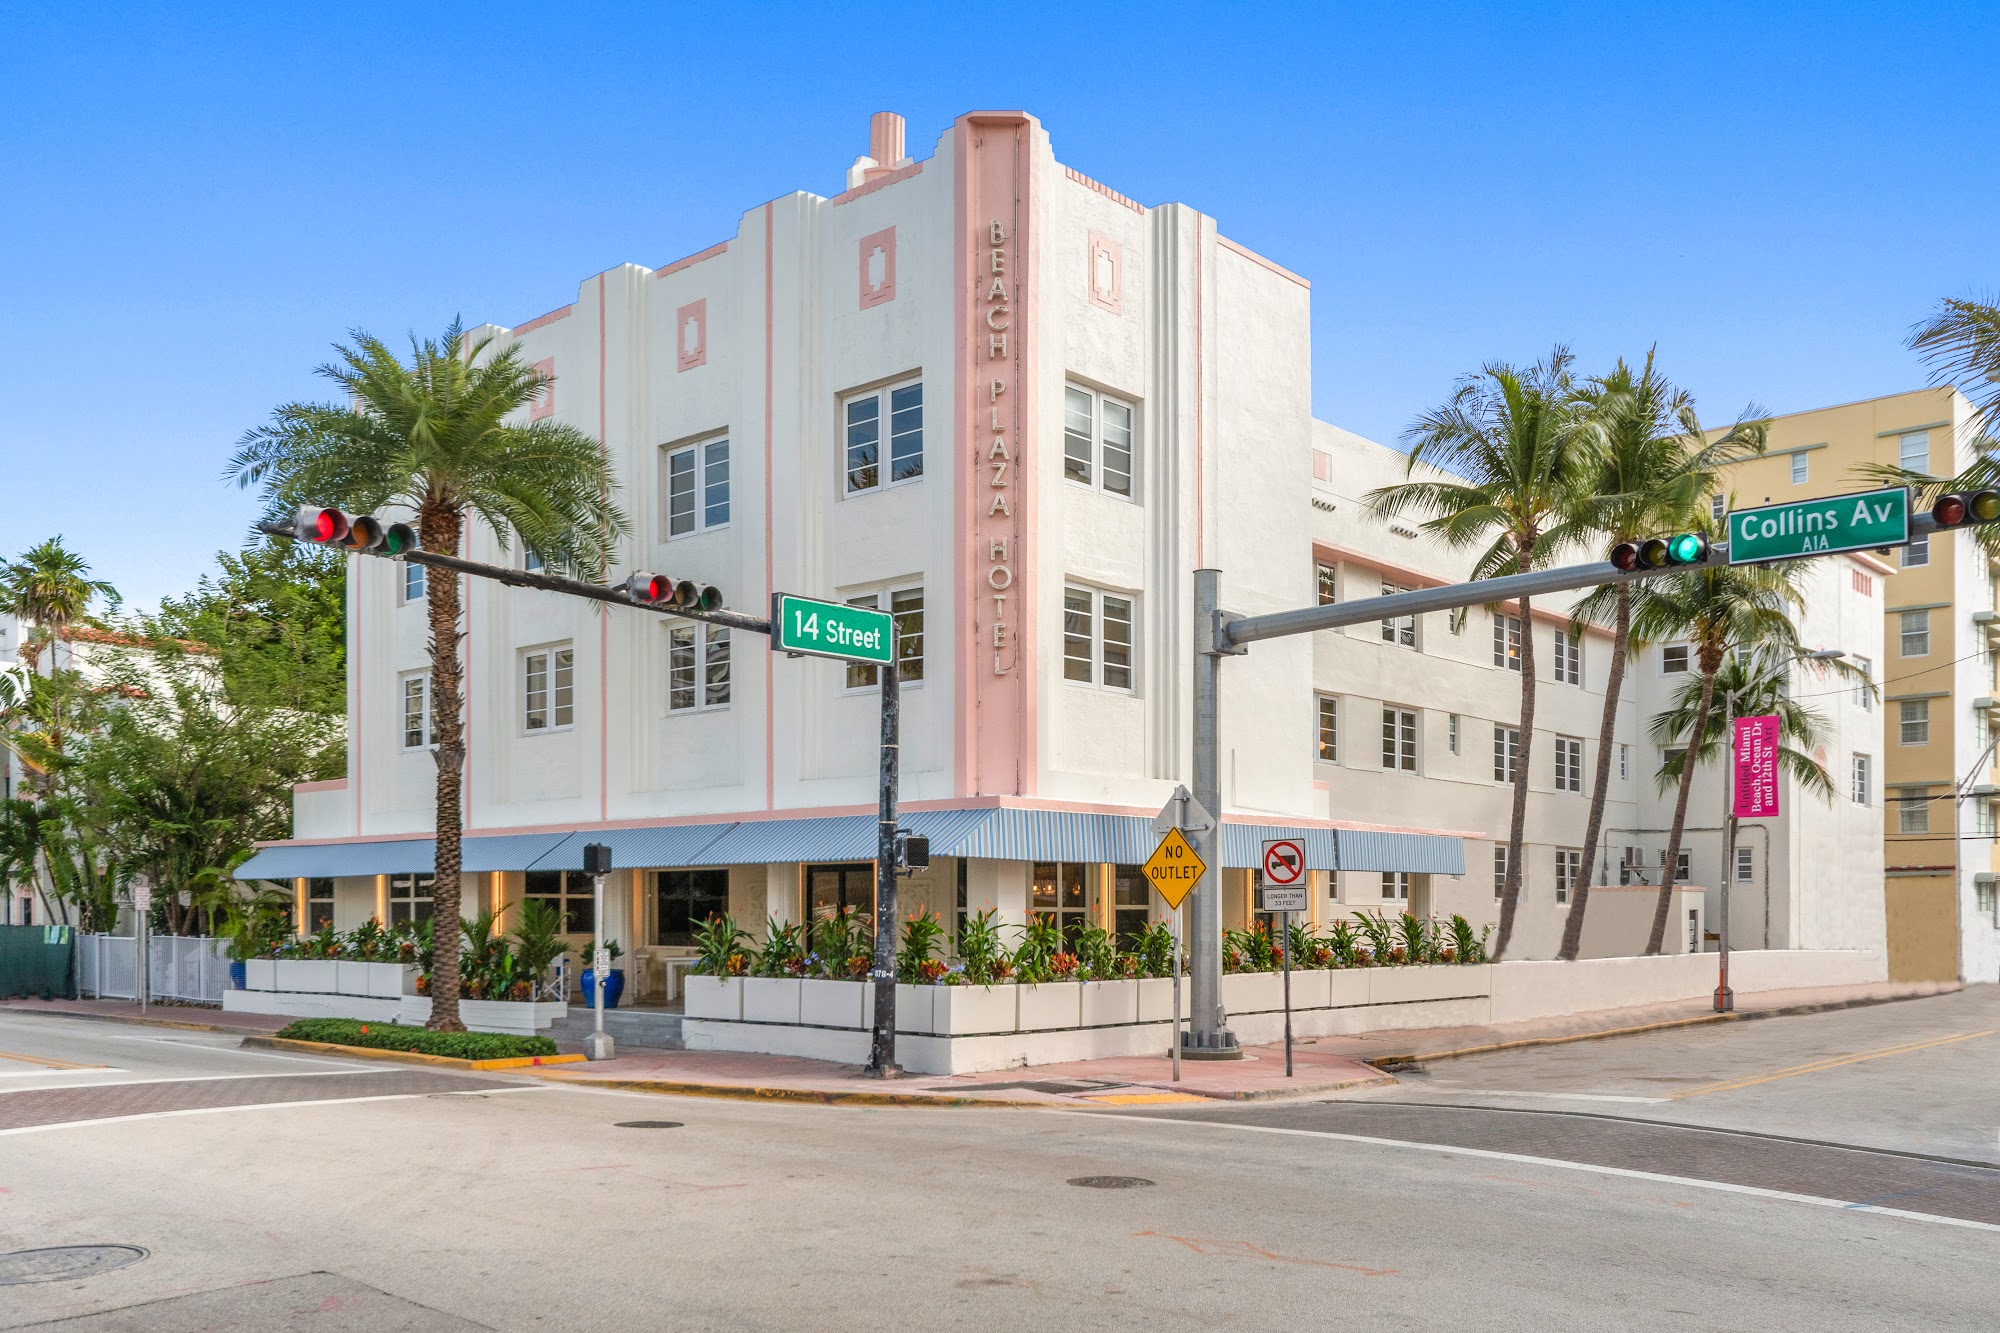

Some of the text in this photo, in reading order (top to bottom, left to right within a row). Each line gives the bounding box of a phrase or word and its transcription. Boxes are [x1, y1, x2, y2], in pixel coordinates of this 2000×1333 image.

[987, 219, 1012, 676] BEACH PLAZA HOTEL
[1741, 499, 1893, 541] Collins Av
[1802, 533, 1829, 552] A1A
[795, 609, 881, 650] 14 Street
[1740, 726, 1751, 809] Untitled Miami
[1751, 721, 1763, 813] Beach, Ocean Dr
[1762, 727, 1773, 806] and 12th St Art
[1151, 865, 1198, 880] OUTLET
[1165, 845, 1183, 859] NO
